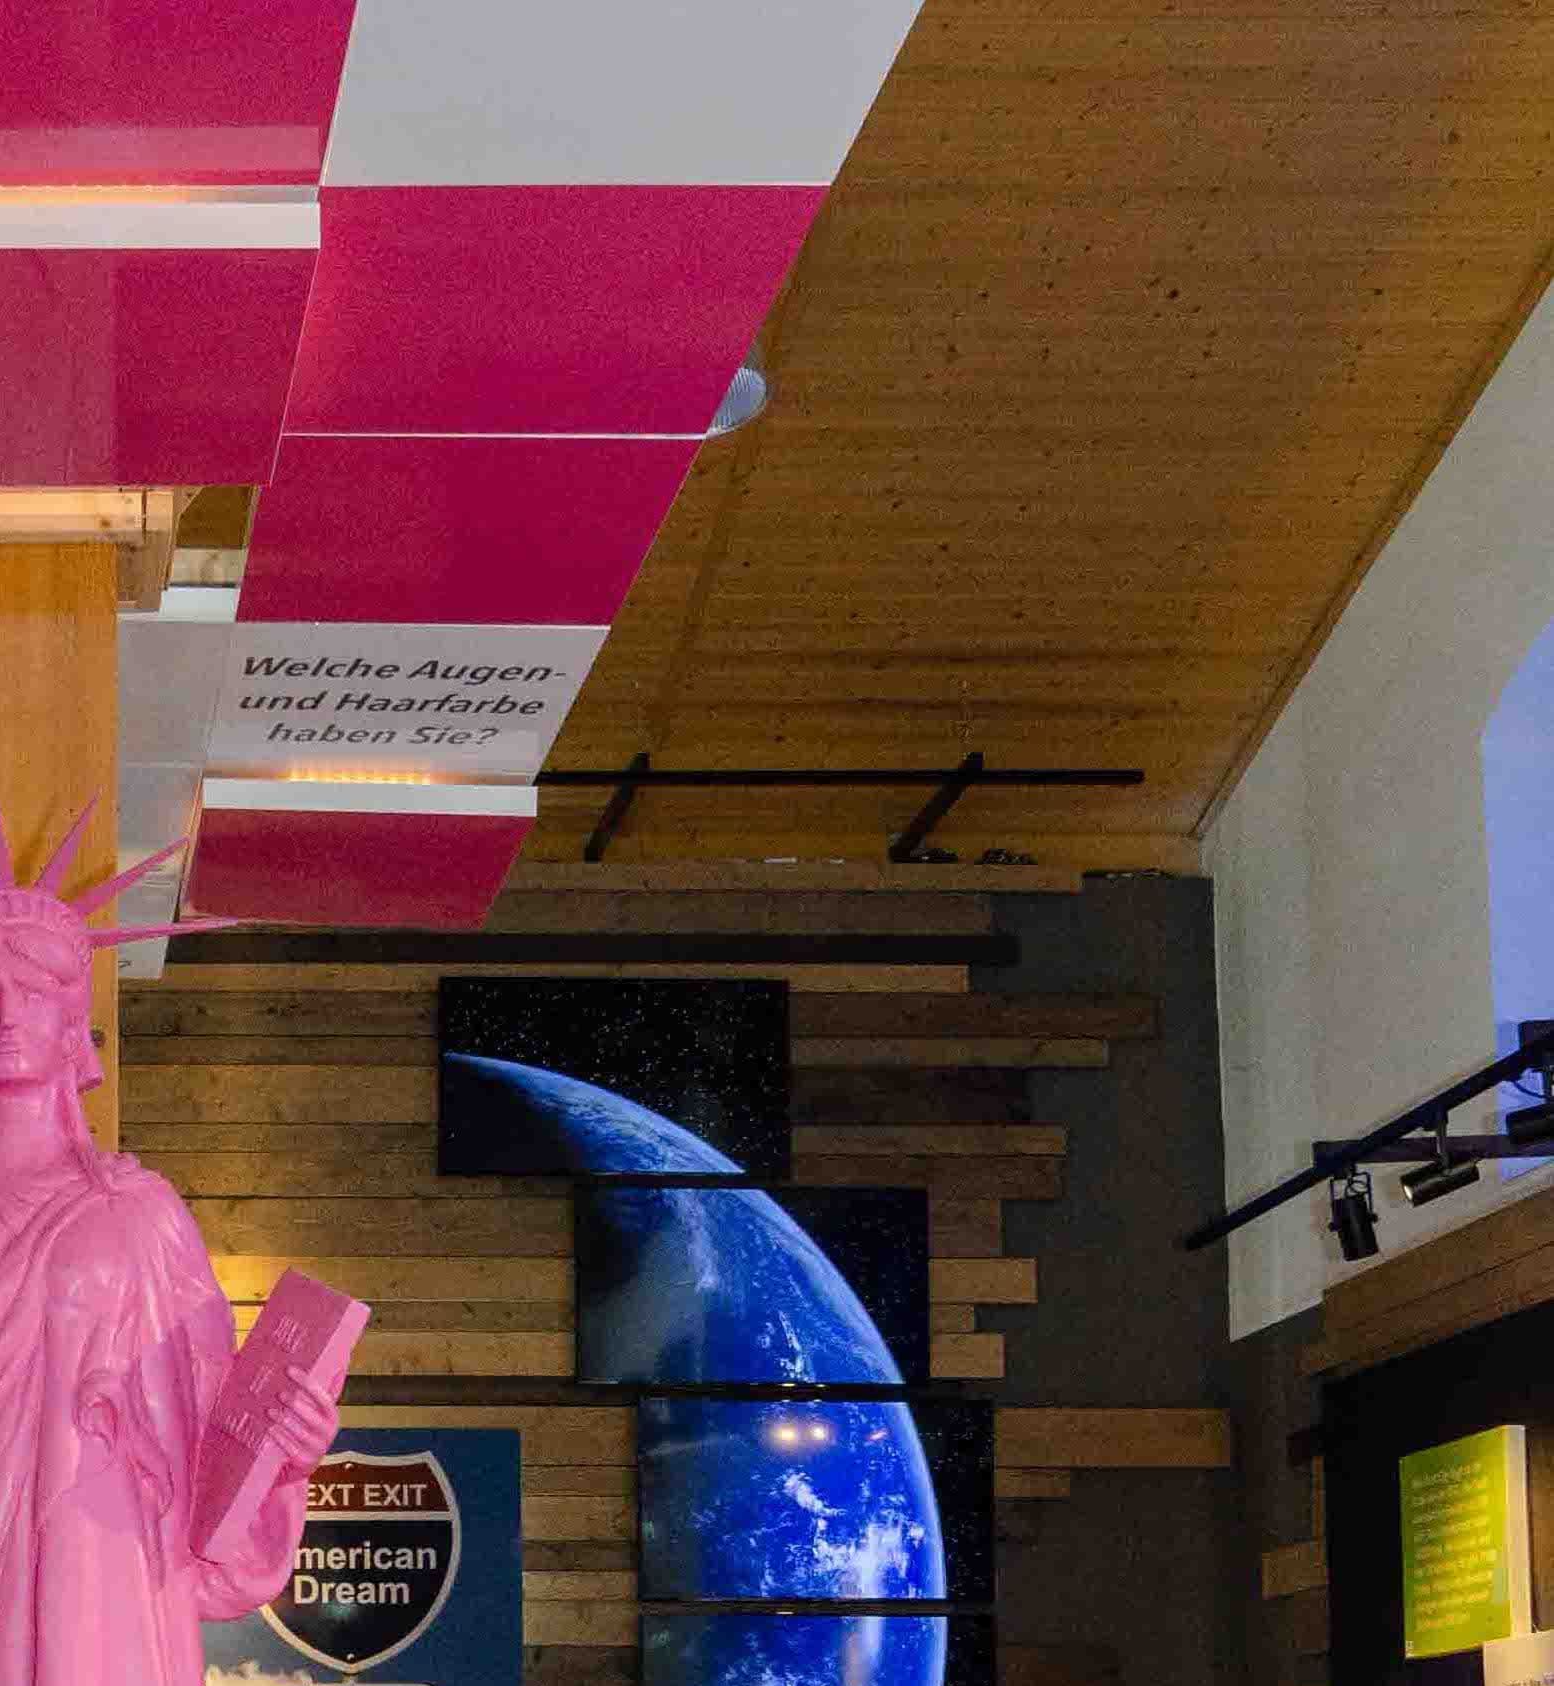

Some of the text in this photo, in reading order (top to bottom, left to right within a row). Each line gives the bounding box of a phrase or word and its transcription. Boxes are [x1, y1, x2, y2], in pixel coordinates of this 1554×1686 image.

[243, 655, 567, 688] Welche Augen-
[238, 689, 545, 717] und Haarfarbe
[265, 723, 499, 747] haben Sie?
[306, 1483, 427, 1507] EXT EXIT
[294, 1540, 437, 1571] merican
[293, 1575, 410, 1605] Dream
